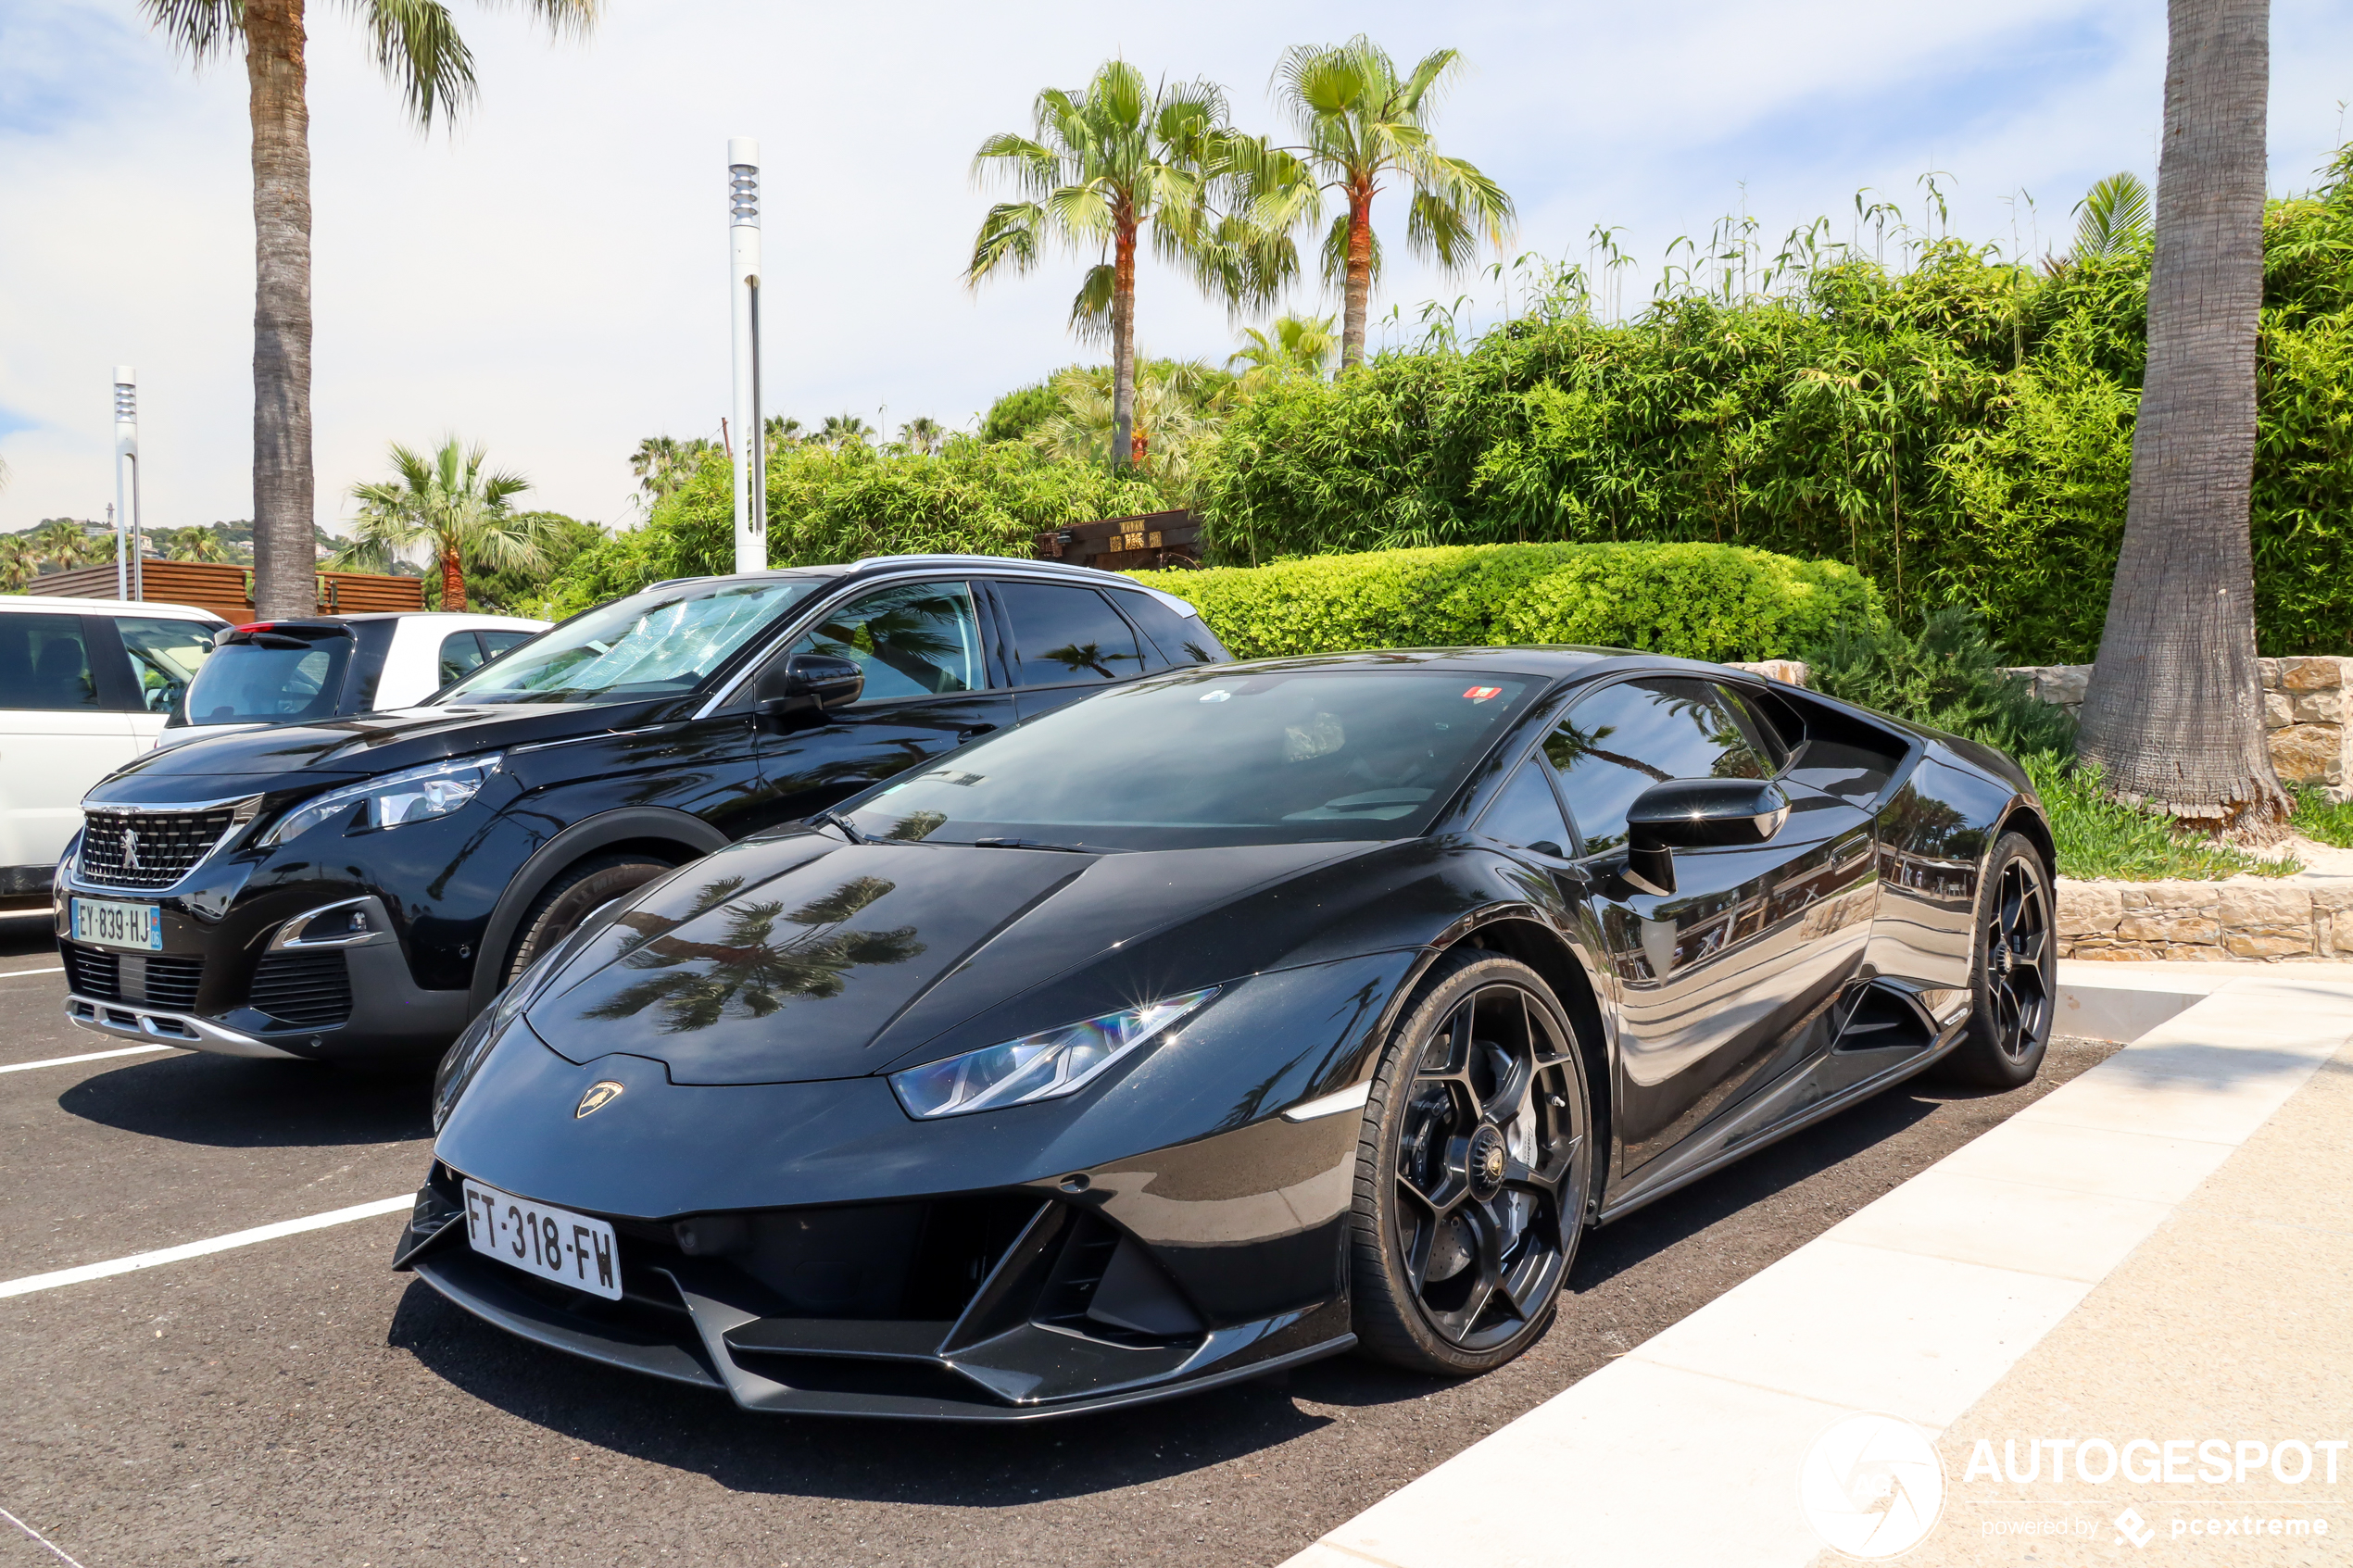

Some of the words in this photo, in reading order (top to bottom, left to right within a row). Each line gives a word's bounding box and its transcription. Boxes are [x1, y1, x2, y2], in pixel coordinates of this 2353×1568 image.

[80, 905, 149, 943] EY-839-HJ
[151, 931, 160, 946] 06
[467, 1188, 613, 1288] FT-318-FW
